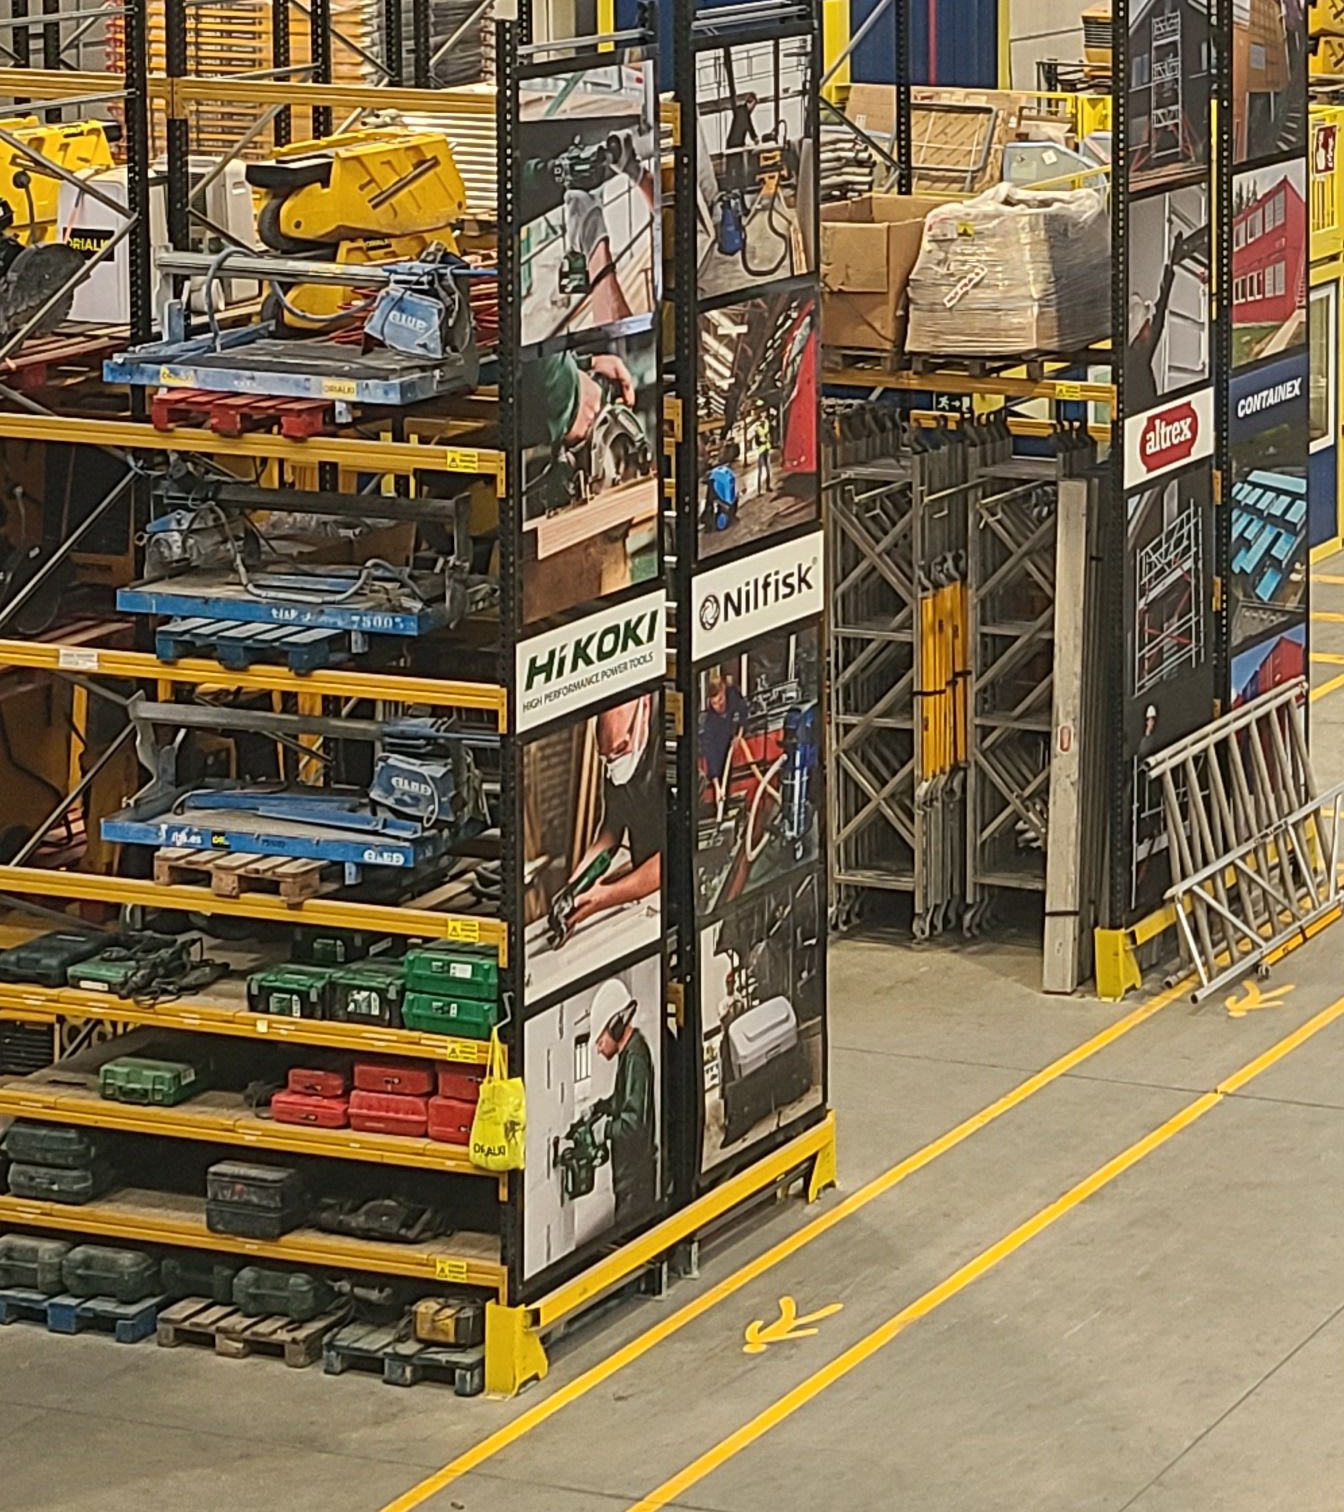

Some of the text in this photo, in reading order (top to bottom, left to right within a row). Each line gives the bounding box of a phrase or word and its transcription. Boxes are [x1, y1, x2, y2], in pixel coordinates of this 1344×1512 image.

[1237, 377, 1302, 418] CONTAINEX
[1146, 417, 1192, 455] altrex
[724, 563, 813, 623] Nilfisk
[522, 650, 654, 713] HIGH PERFORMANCE POWER TOOLS
